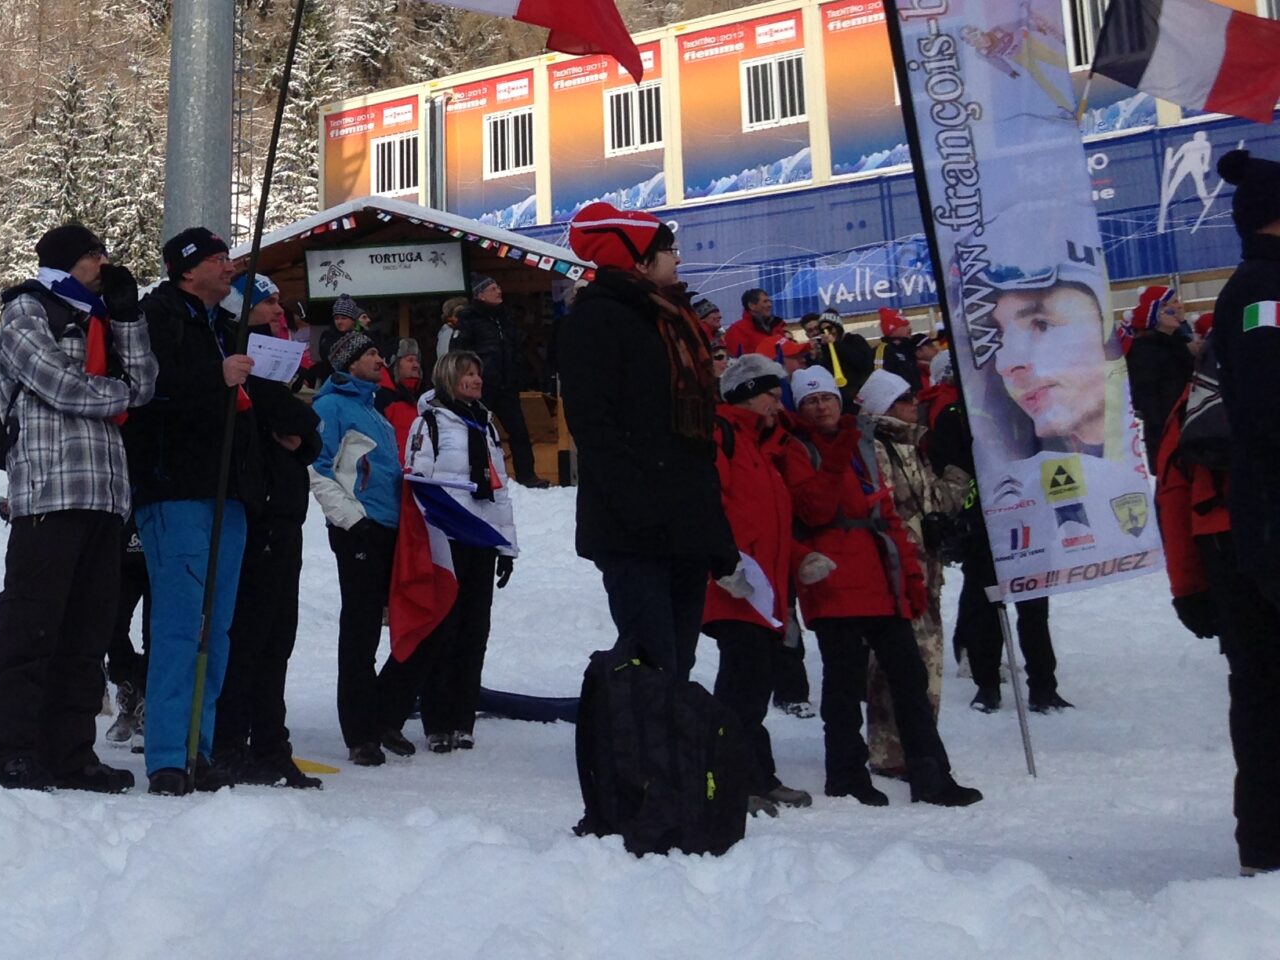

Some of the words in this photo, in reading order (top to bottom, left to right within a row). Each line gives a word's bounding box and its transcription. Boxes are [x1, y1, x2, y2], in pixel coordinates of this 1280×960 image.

[827, 12, 886, 32] fiemm
[683, 42, 745, 61] fiemme
[553, 71, 608, 90] fiemme
[329, 122, 375, 138] fiemme
[368, 251, 423, 265] TORTUGA
[1009, 576, 1038, 594] Go
[1045, 569, 1062, 589] !!!
[1067, 550, 1150, 584] FOUEZ
